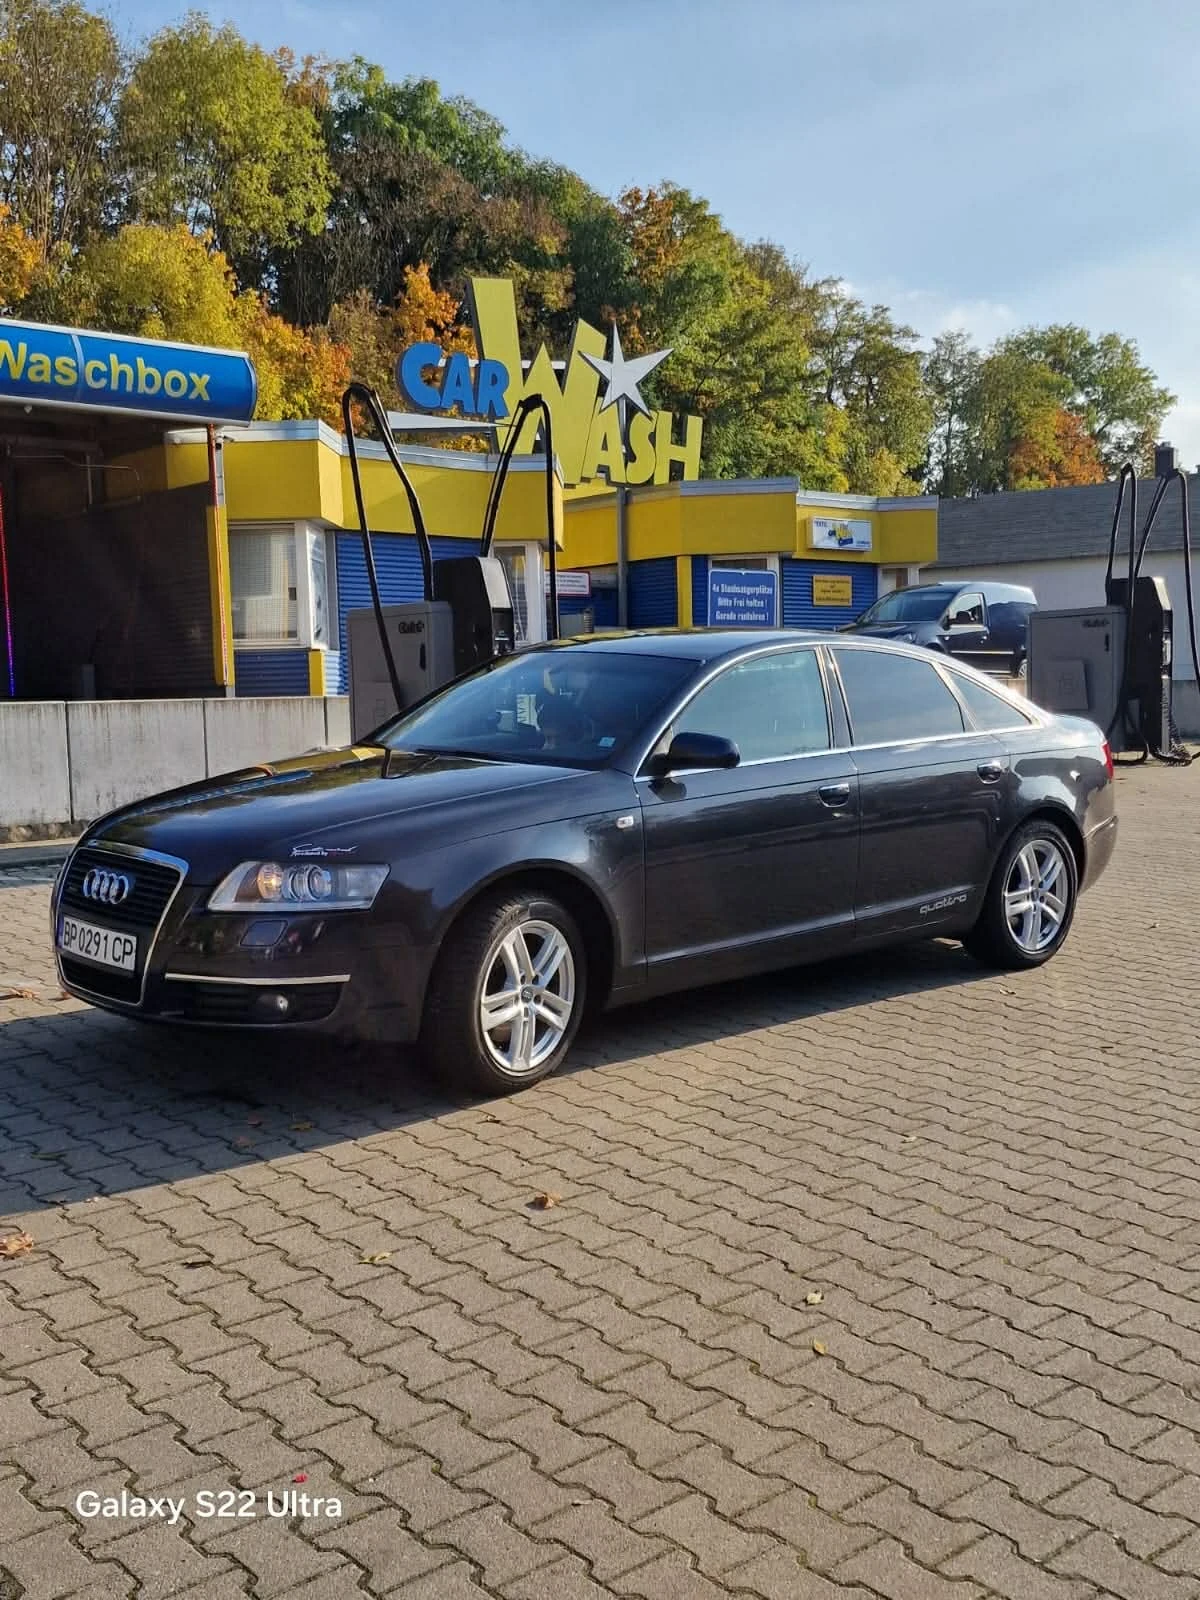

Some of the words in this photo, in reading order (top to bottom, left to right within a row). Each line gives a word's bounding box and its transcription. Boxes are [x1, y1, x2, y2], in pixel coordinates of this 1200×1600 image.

[401, 342, 509, 417] CAR
[471, 277, 703, 485] WASH
[919, 893, 968, 921] quattro
